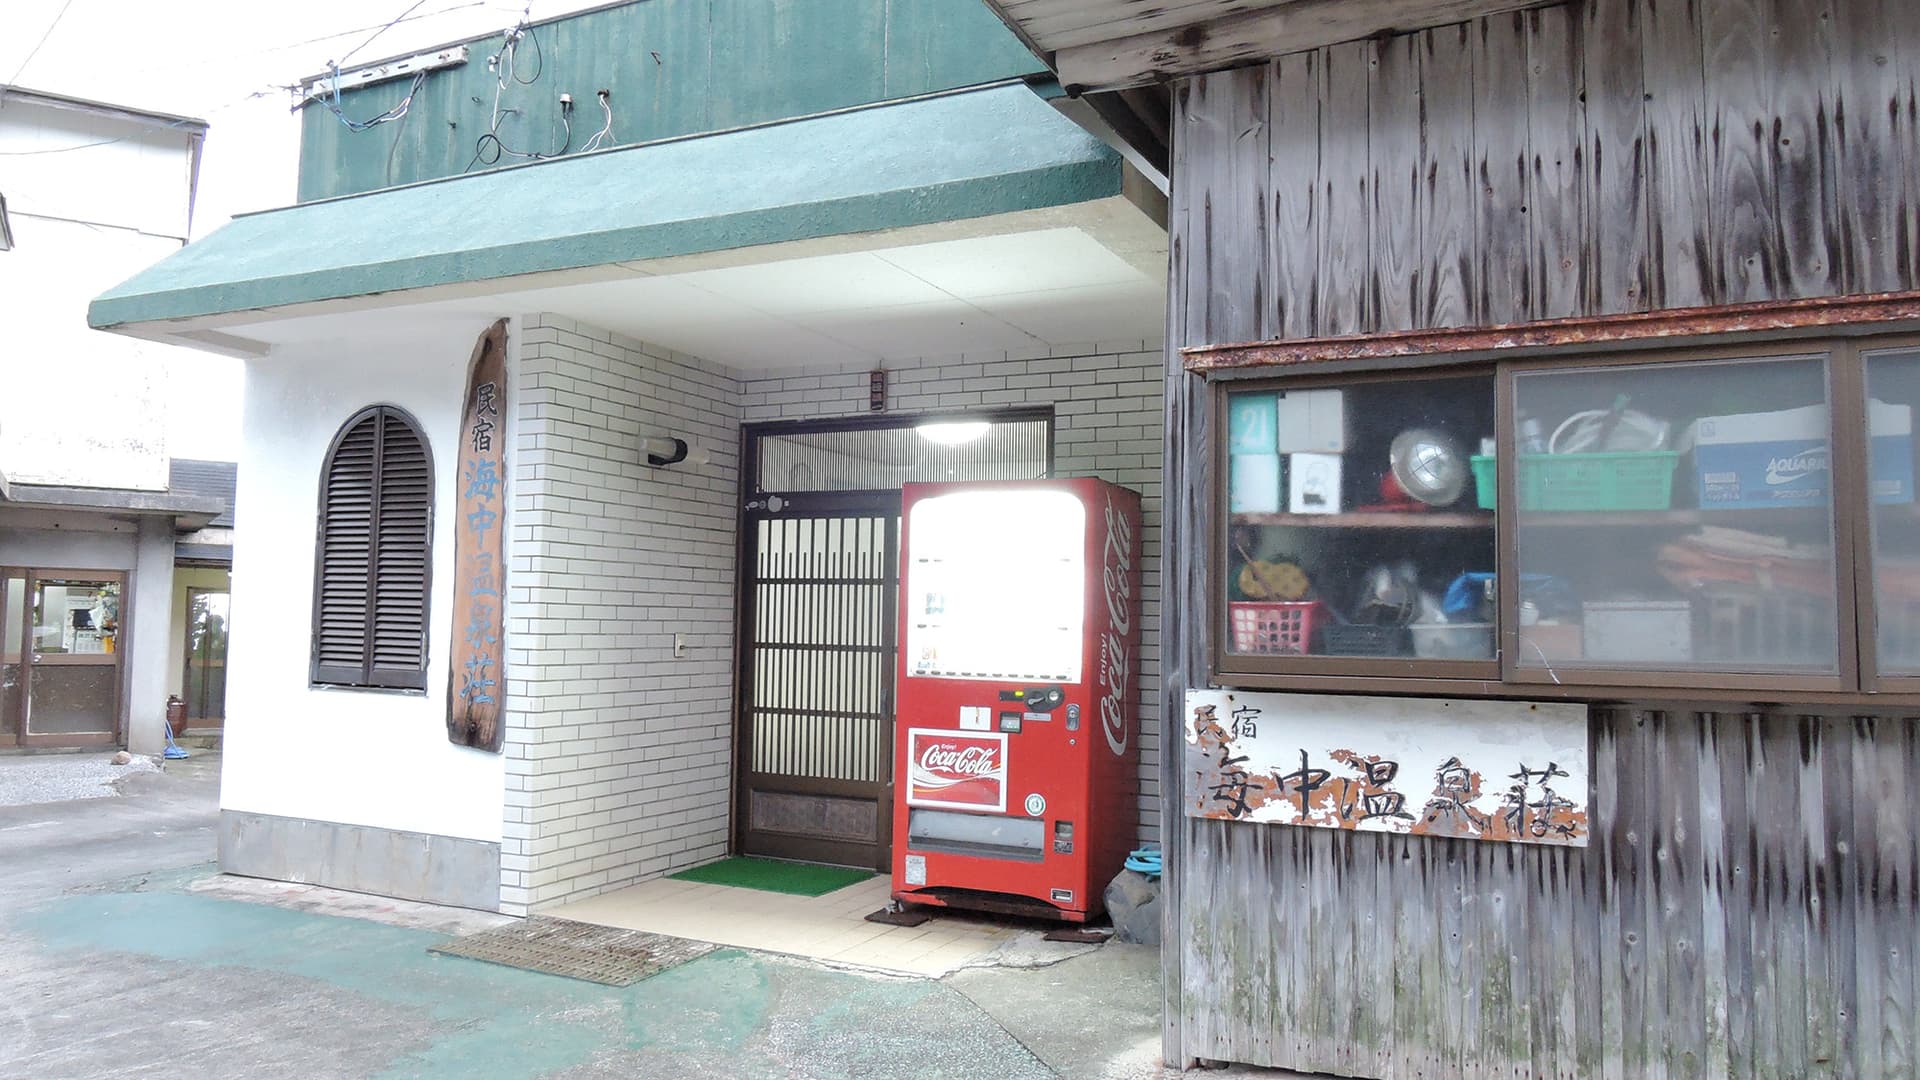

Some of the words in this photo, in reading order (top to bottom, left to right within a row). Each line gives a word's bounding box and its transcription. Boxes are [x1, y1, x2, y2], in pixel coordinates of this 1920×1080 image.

[1101, 490, 1133, 757] Coca-Cola
[1099, 632, 1108, 687] Enjoy!
[920, 743, 999, 776] Coca-Cola
